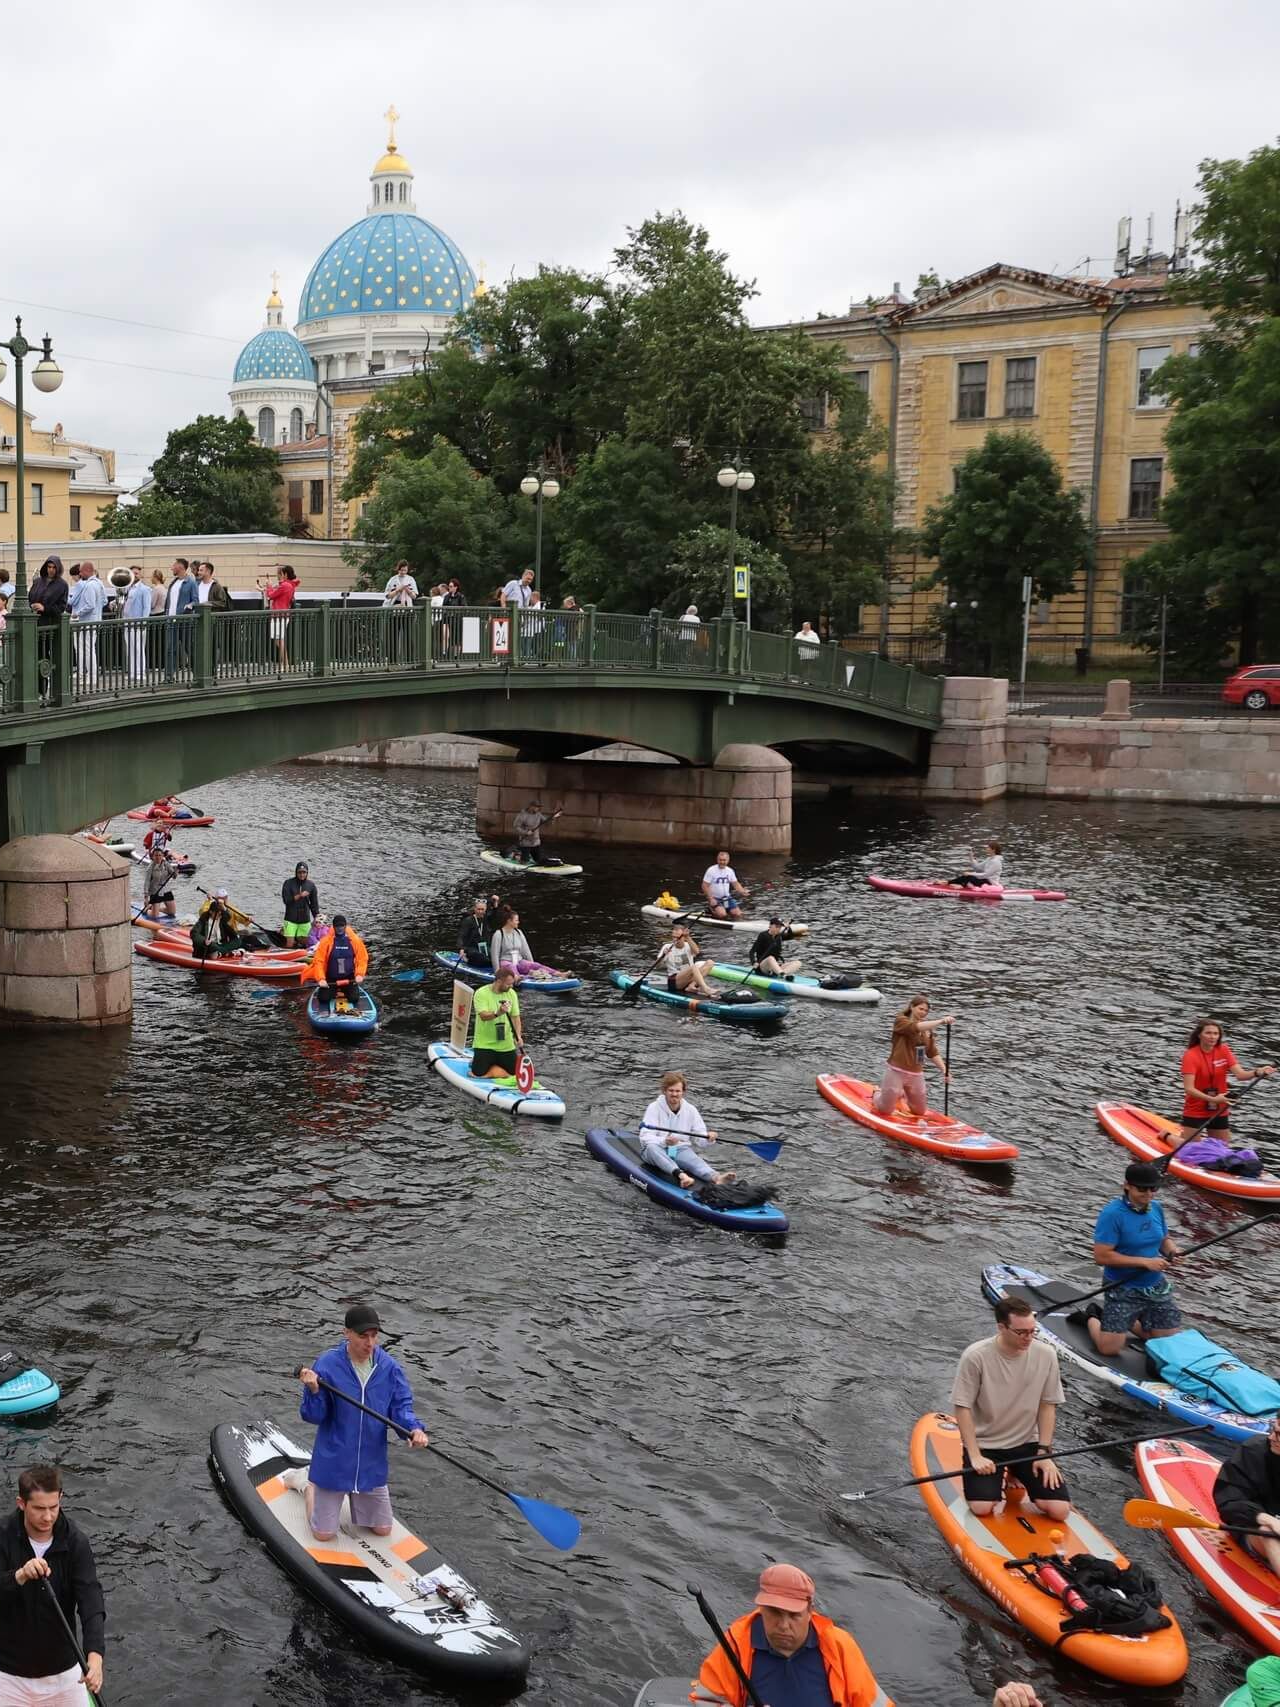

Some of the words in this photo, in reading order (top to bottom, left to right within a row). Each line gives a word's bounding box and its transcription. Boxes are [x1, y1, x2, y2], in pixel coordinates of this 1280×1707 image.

[495, 630, 506, 647] 24
[358, 1540, 370, 1550] TO
[368, 1549, 393, 1569] BRING
